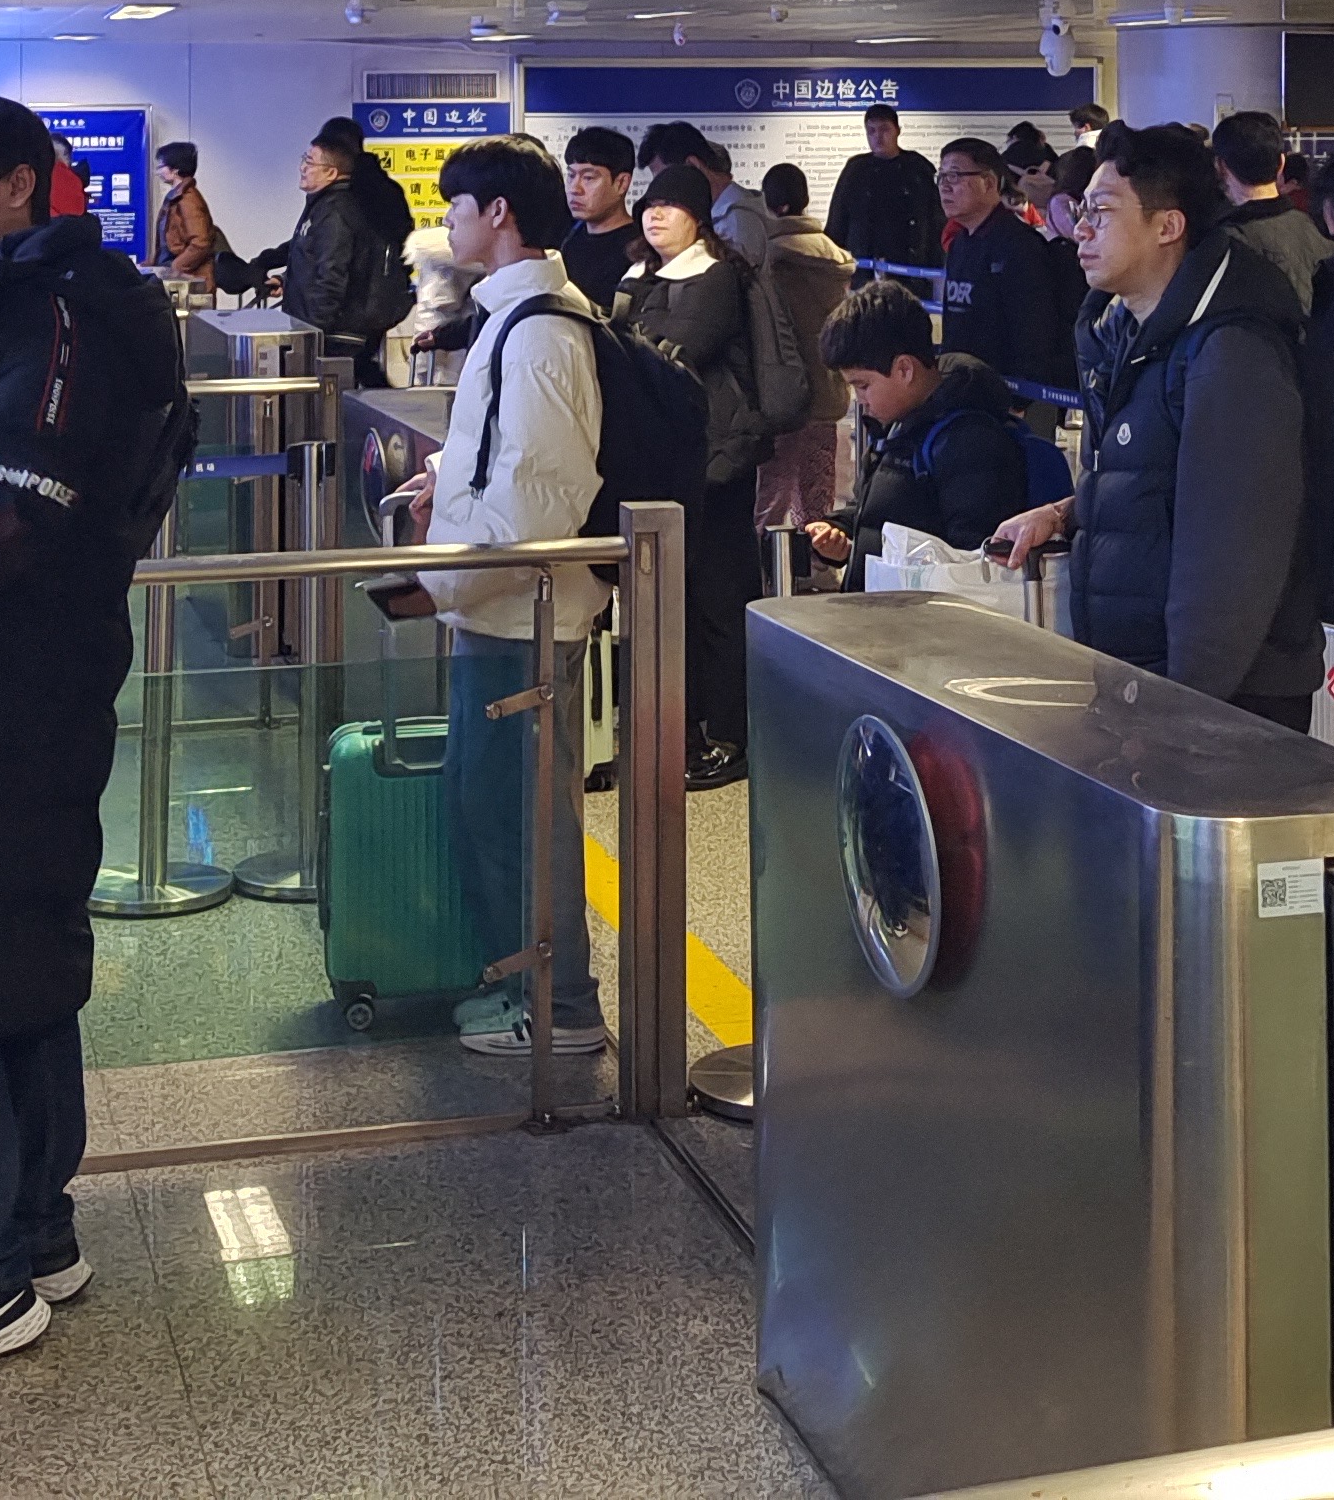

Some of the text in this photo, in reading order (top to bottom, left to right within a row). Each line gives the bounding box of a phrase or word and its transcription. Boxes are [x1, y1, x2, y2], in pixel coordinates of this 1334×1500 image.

[772, 78, 900, 100] 中国边检公告
[402, 106, 487, 127] 中国边检
